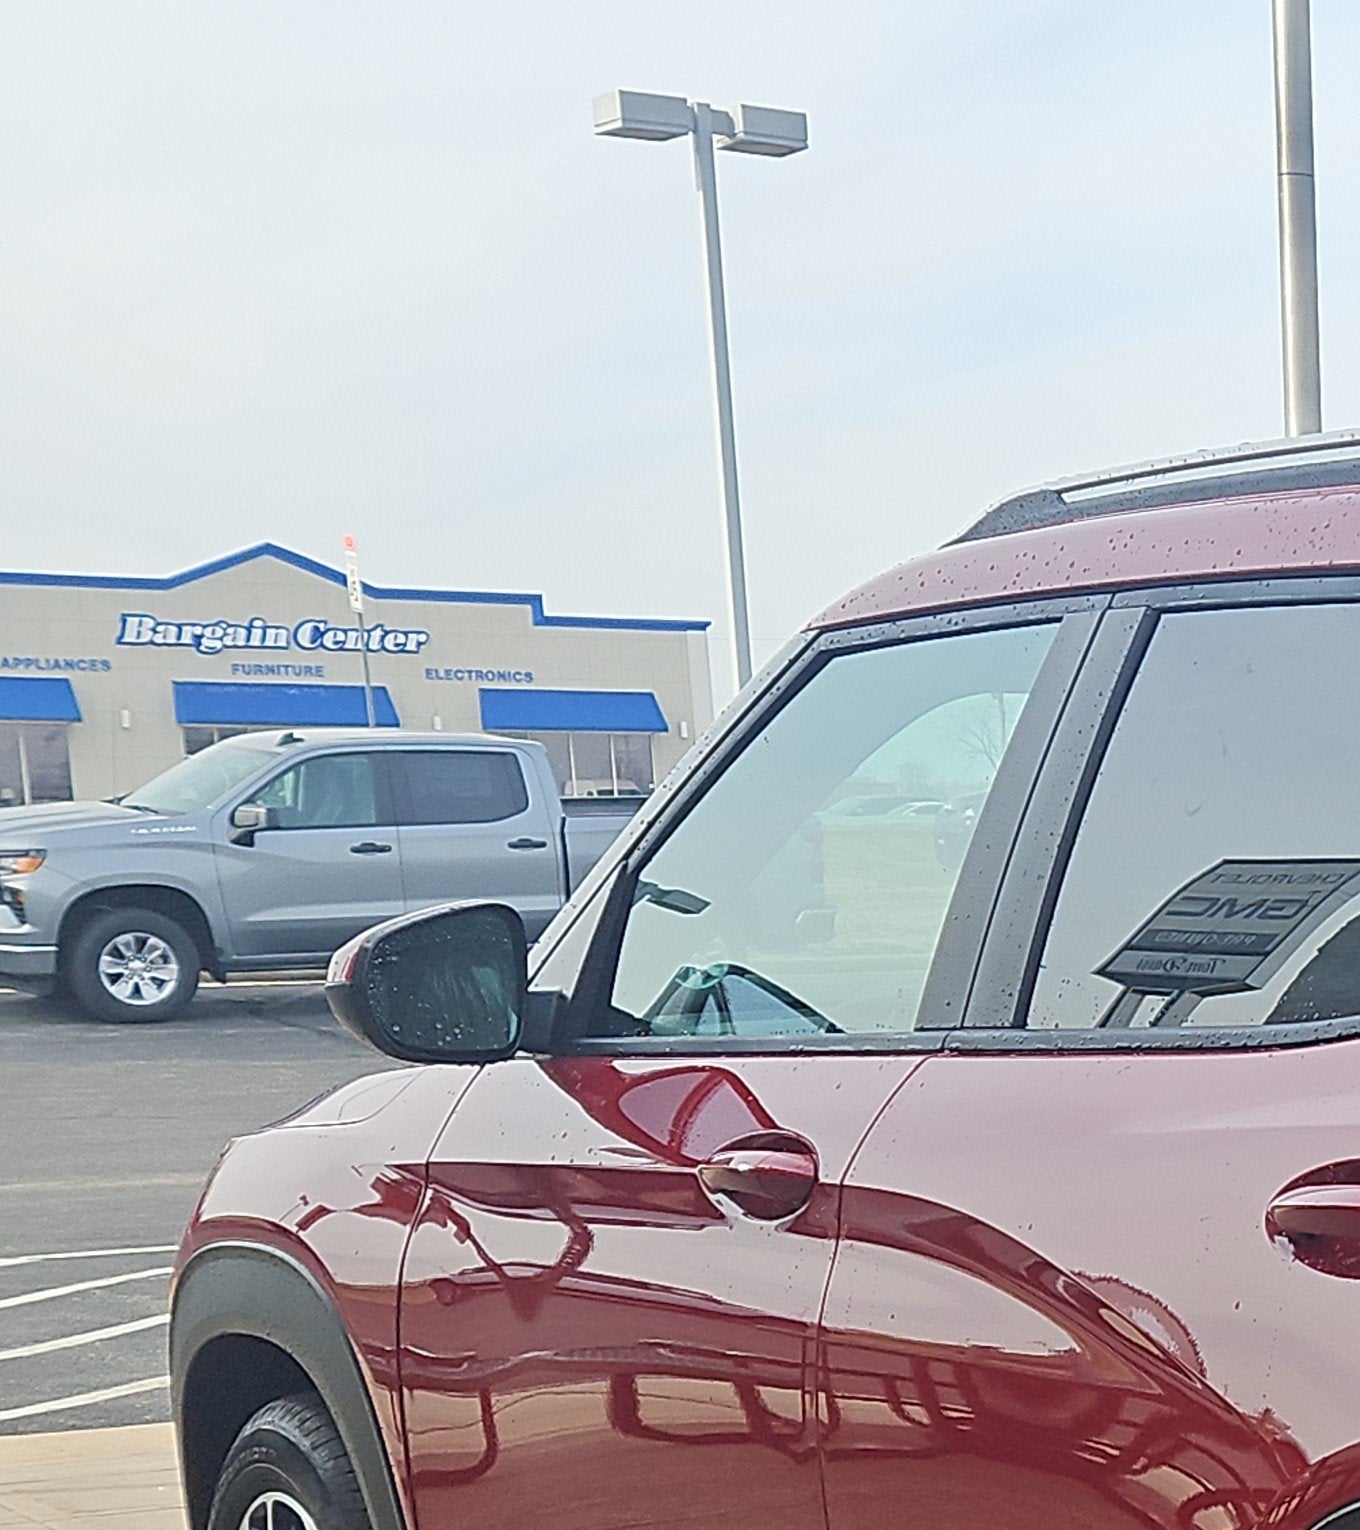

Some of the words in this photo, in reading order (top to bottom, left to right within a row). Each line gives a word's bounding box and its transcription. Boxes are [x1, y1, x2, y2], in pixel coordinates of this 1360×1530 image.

[116, 613, 290, 655] Bargain
[294, 618, 430, 654] Center
[0, 657, 112, 673] APPLIANCES
[231, 663, 325, 678] FURNITURE
[425, 668, 534, 683] ELECTRONICS
